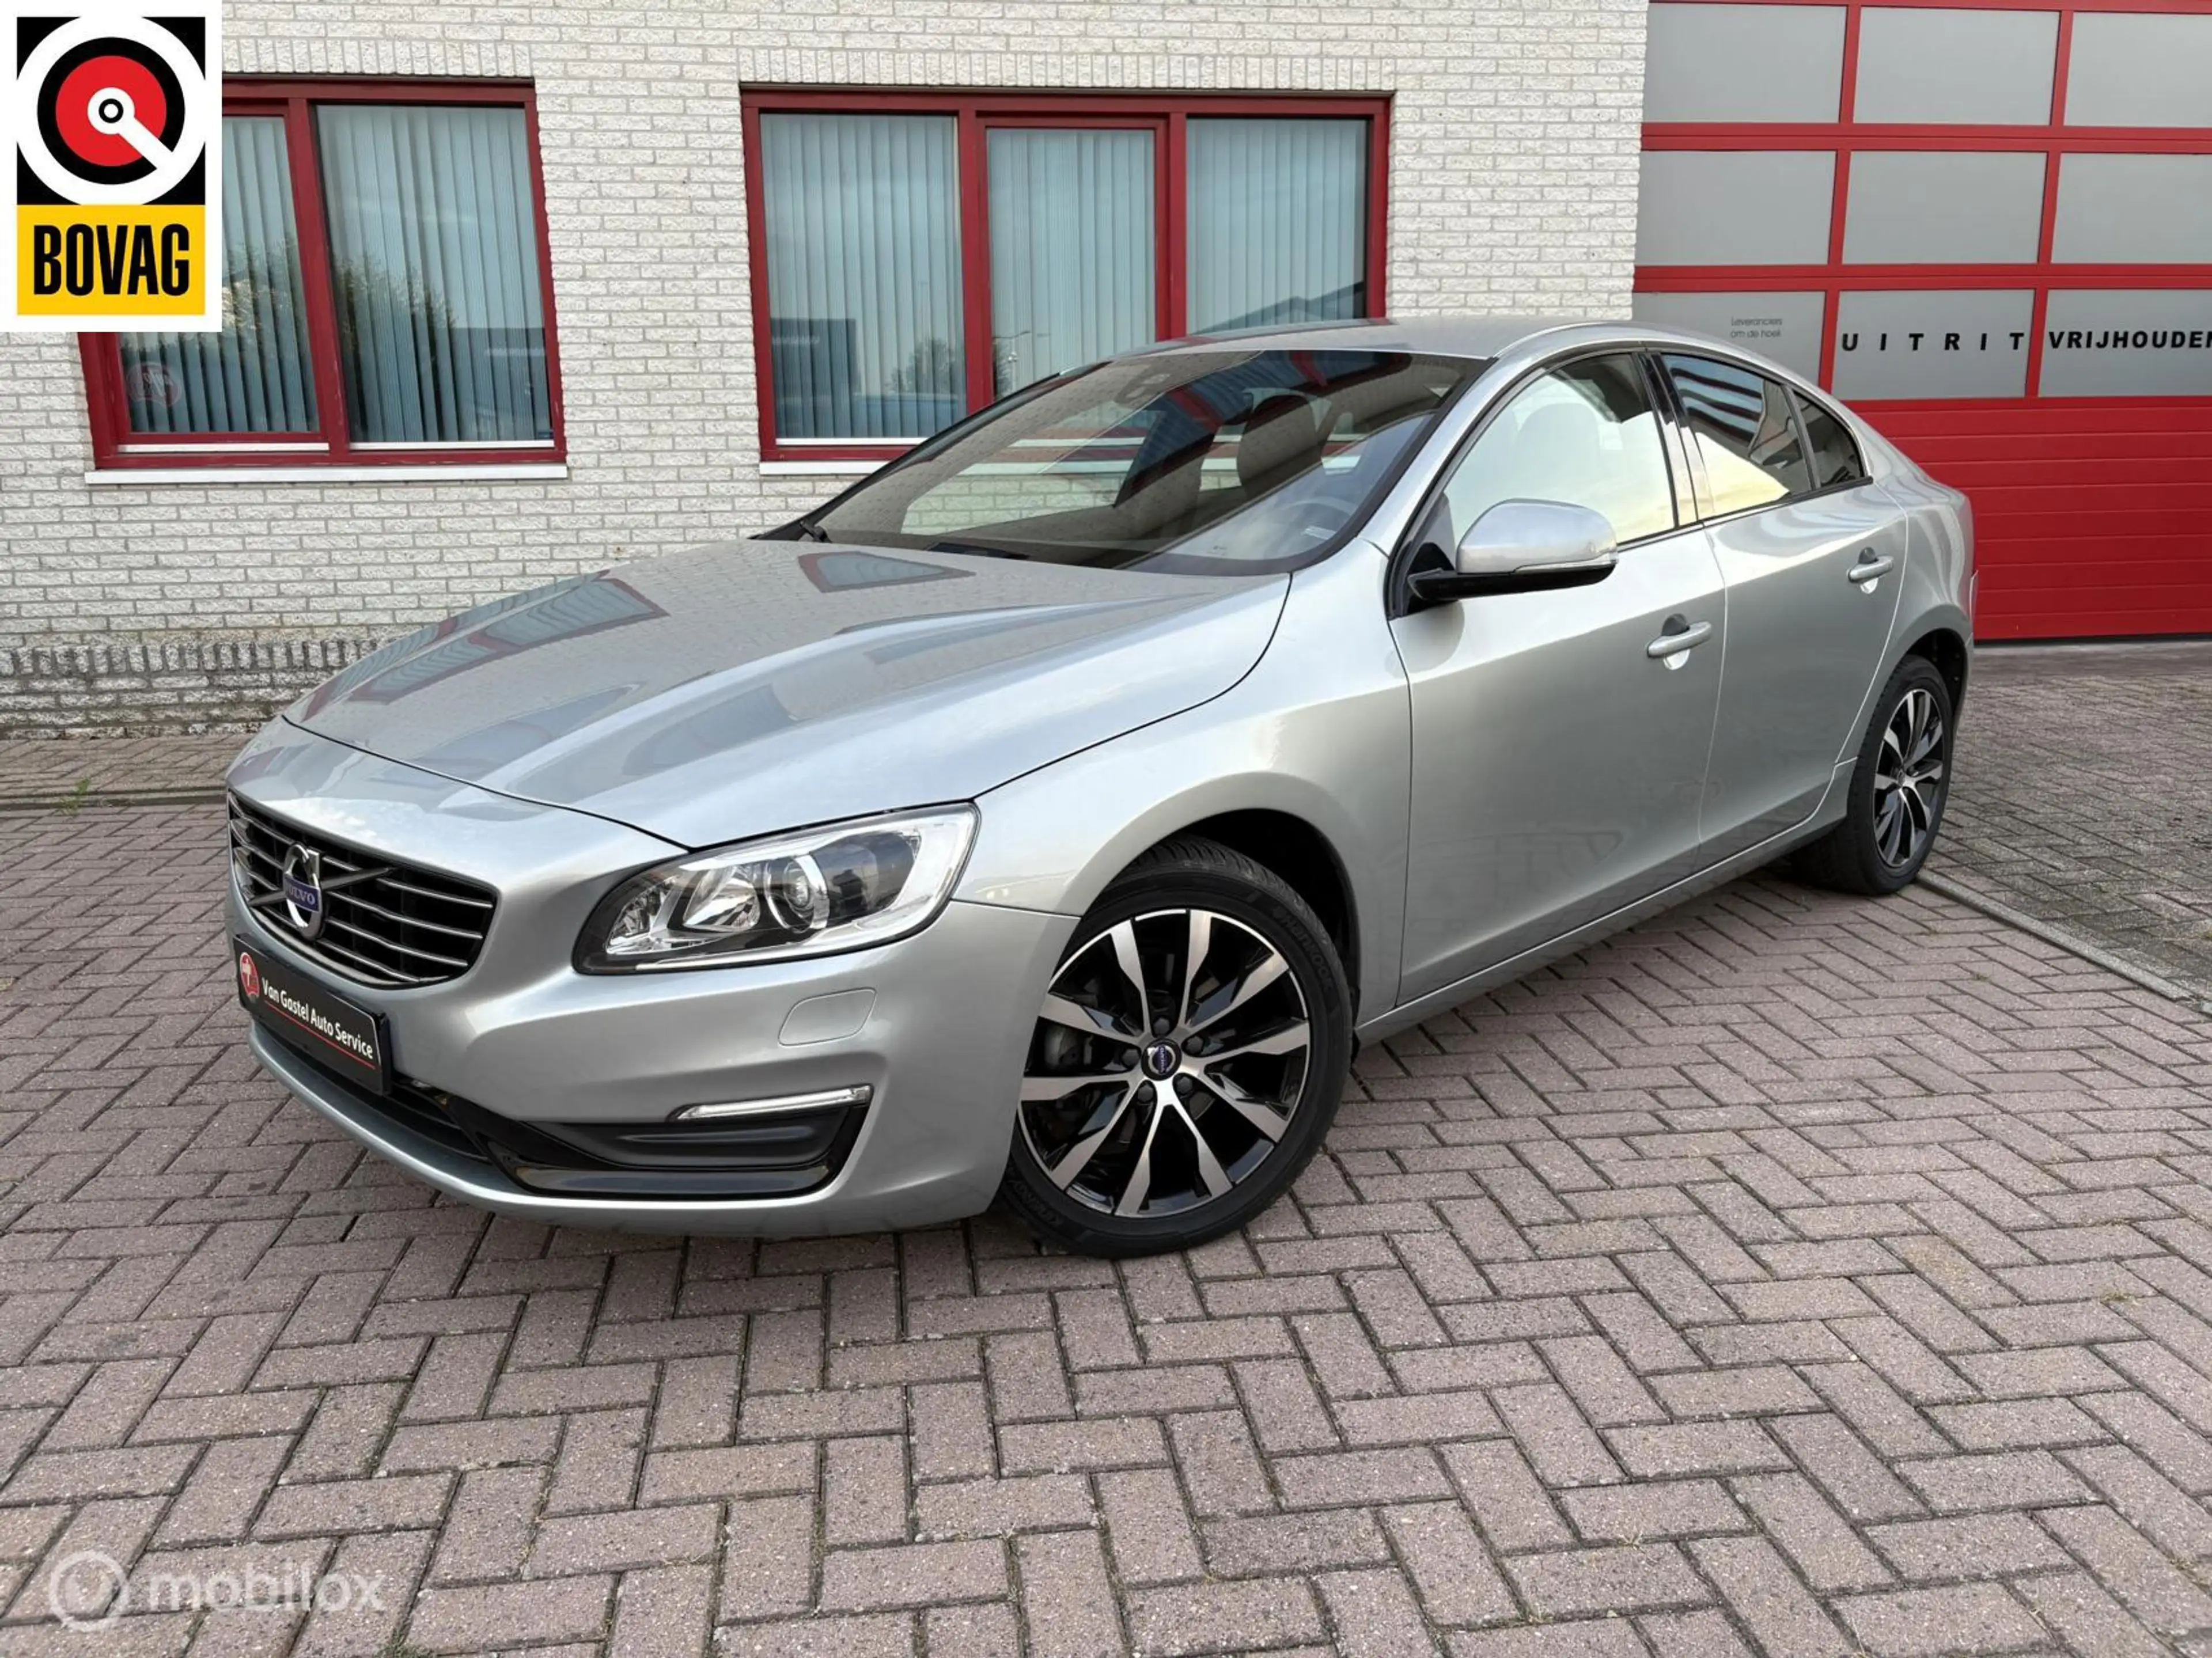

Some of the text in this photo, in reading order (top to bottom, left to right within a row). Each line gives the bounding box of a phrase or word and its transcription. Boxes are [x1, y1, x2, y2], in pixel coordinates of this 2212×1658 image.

[1842, 333, 2025, 351] UITRIT
[262, 977, 374, 1060] Van Gastel Auto Service
